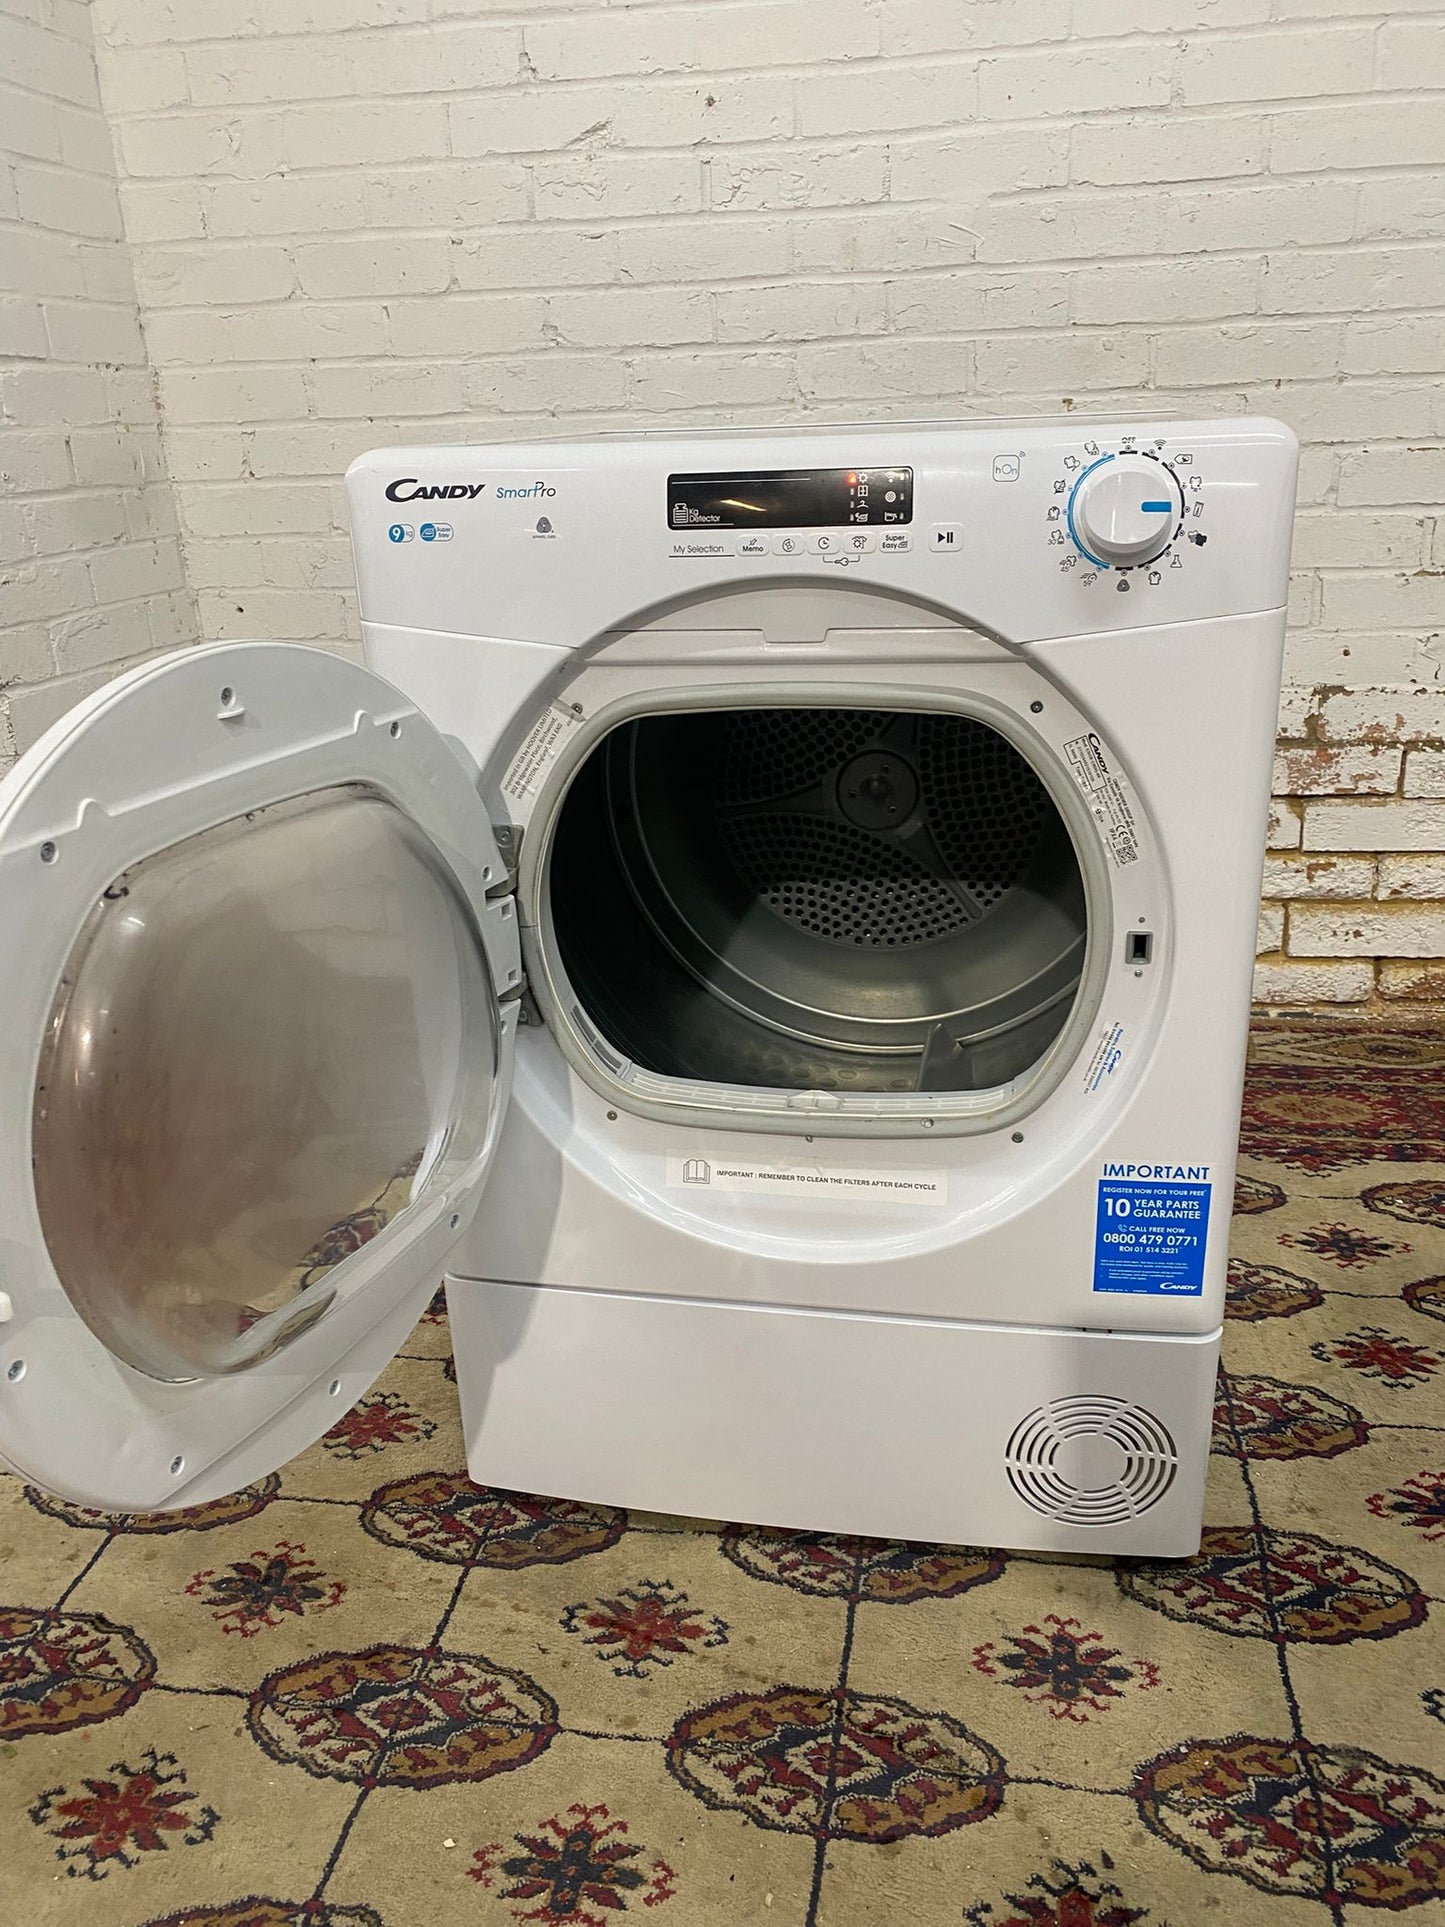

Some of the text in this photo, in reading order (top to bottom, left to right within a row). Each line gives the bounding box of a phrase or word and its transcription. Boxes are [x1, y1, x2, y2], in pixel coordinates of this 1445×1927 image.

[1121, 436, 1136, 444] OFF
[385, 478, 486, 503] CANDY
[689, 508, 699, 517] Kg
[689, 515, 721, 523] Detector
[392, 527, 401, 541] 9
[673, 545, 724, 554] My Selection
[882, 542, 897, 550] Easy
[527, 728, 540, 749] HOOVER
[1088, 732, 1109, 774] CANDY
[717, 1170, 753, 1178] IMPORTANT
[758, 1173, 795, 1181] REMEMBER
[1103, 1164, 1210, 1180] IMPORTANT
[1104, 1198, 1199, 1217] 10 YEAR PARTS
[1133, 1209, 1201, 1219] GUARANTEE
[1103, 1233, 1197, 1246] 0800 479 0771
[1160, 1282, 1198, 1291] CANDY
